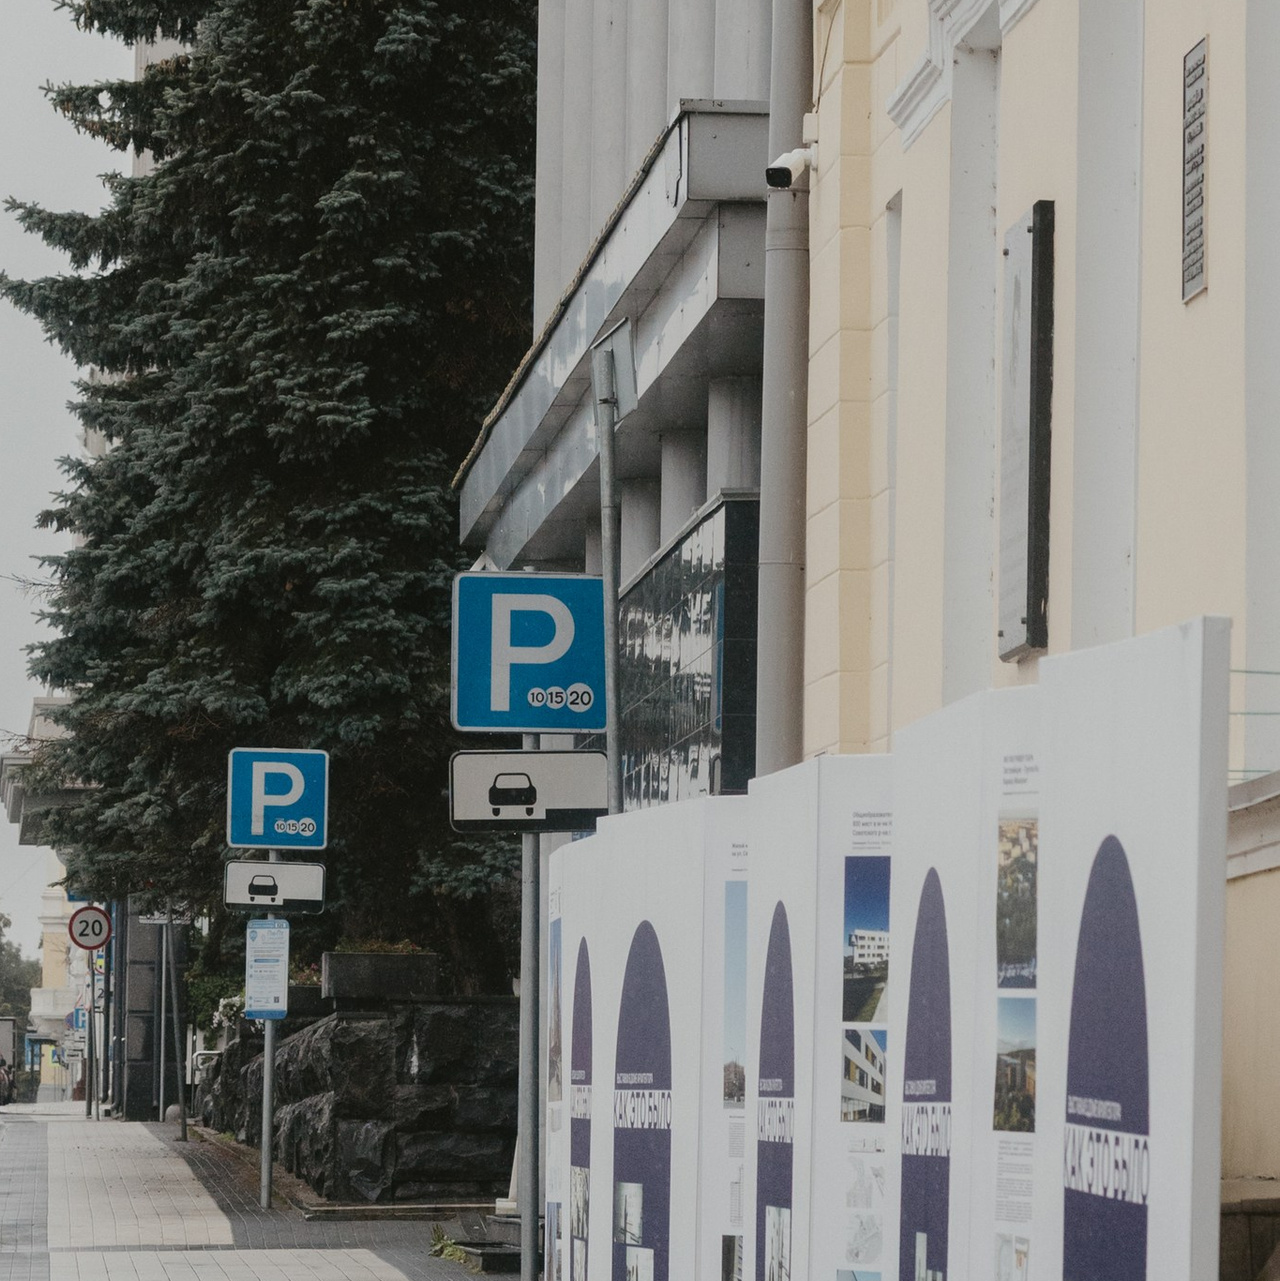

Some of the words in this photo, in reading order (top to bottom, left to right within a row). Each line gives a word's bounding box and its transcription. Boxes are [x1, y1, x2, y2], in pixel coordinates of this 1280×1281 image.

[490, 593, 575, 712] P
[531, 692, 545, 703] 10
[548, 691, 564, 705] 15
[569, 690, 591, 706] 20
[251, 761, 305, 836] P
[276, 823, 286, 831] 10
[287, 823, 298, 832] 15
[300, 822, 315, 833] 20
[79, 920, 103, 937] 20
[630, 1091, 647, 1129] ЭТО
[1087, 1130, 1110, 1197] ЭТО
